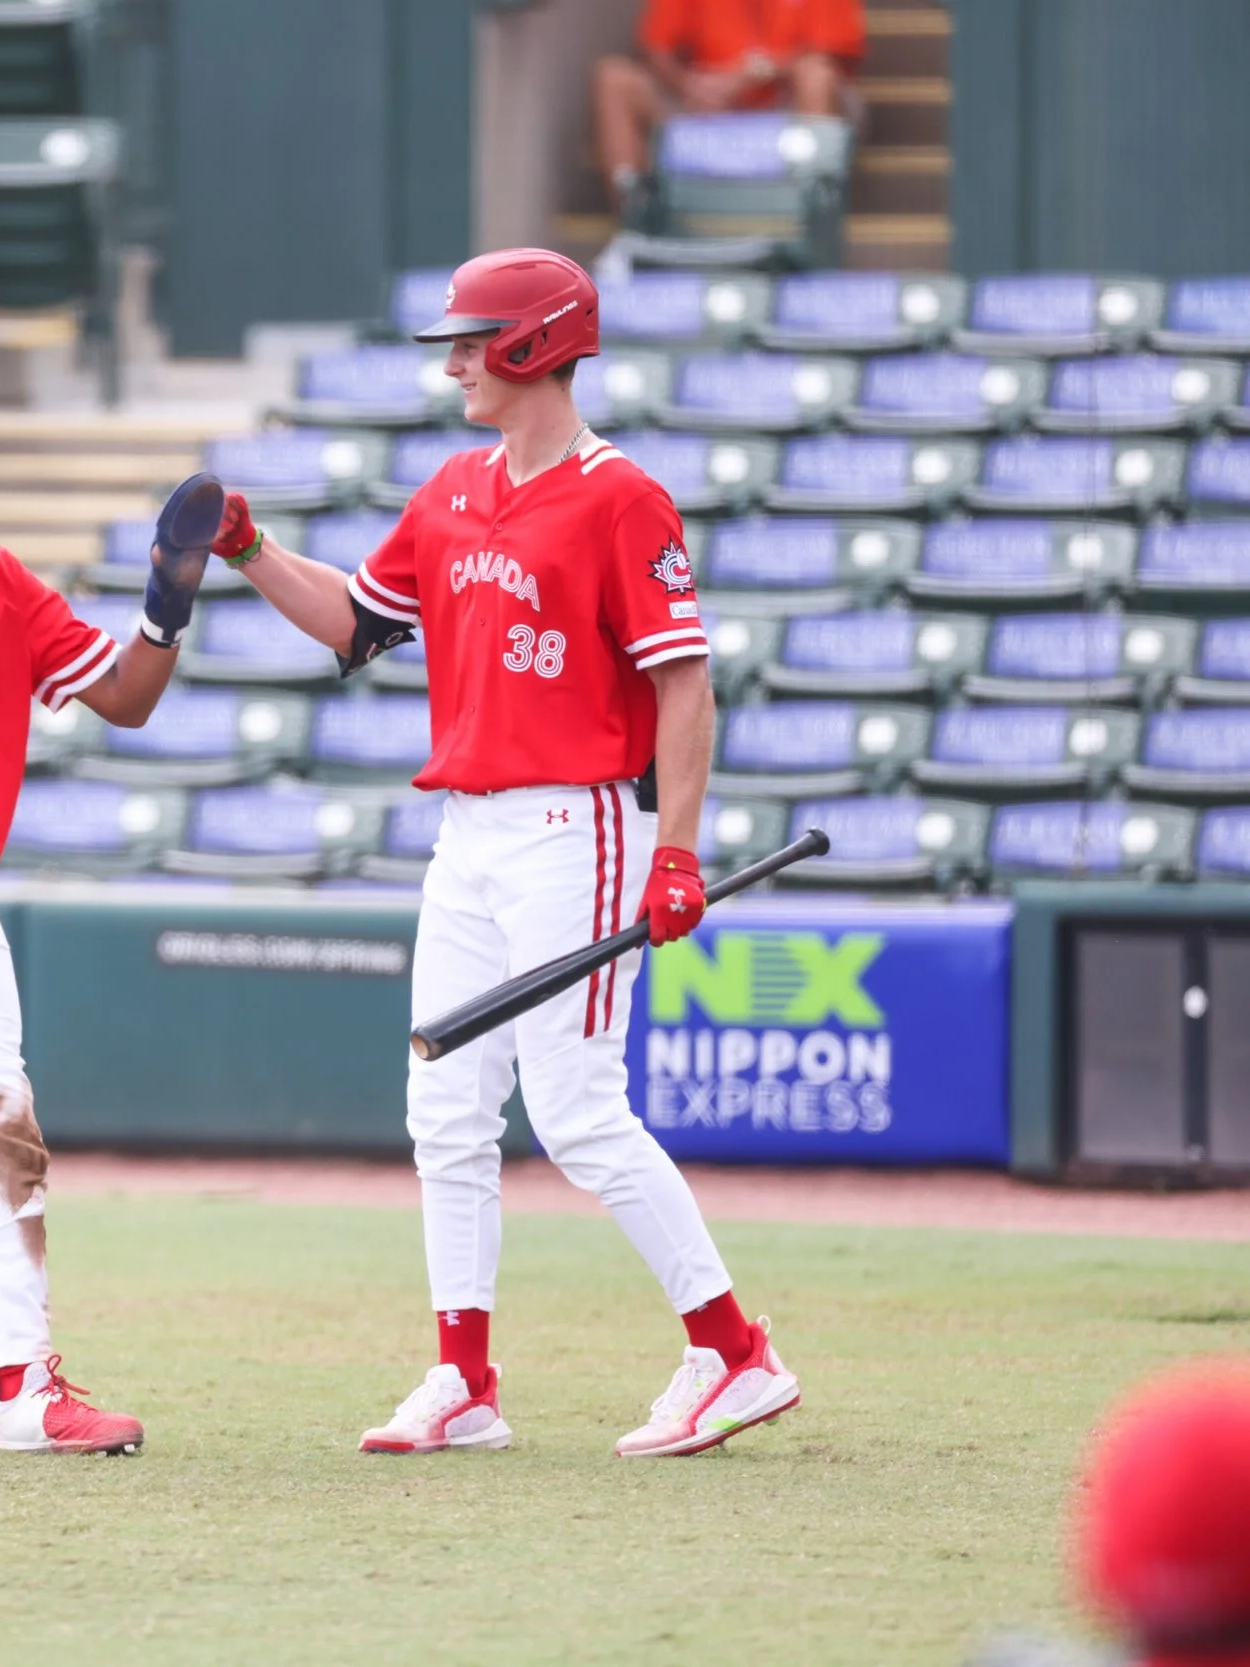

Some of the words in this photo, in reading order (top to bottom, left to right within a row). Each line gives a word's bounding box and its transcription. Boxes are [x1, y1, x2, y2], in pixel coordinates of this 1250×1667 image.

[450, 551, 540, 612] CANADA
[503, 624, 566, 678] 38
[645, 1027, 892, 1085] NIPPON
[645, 1077, 892, 1134] EXPRESS
